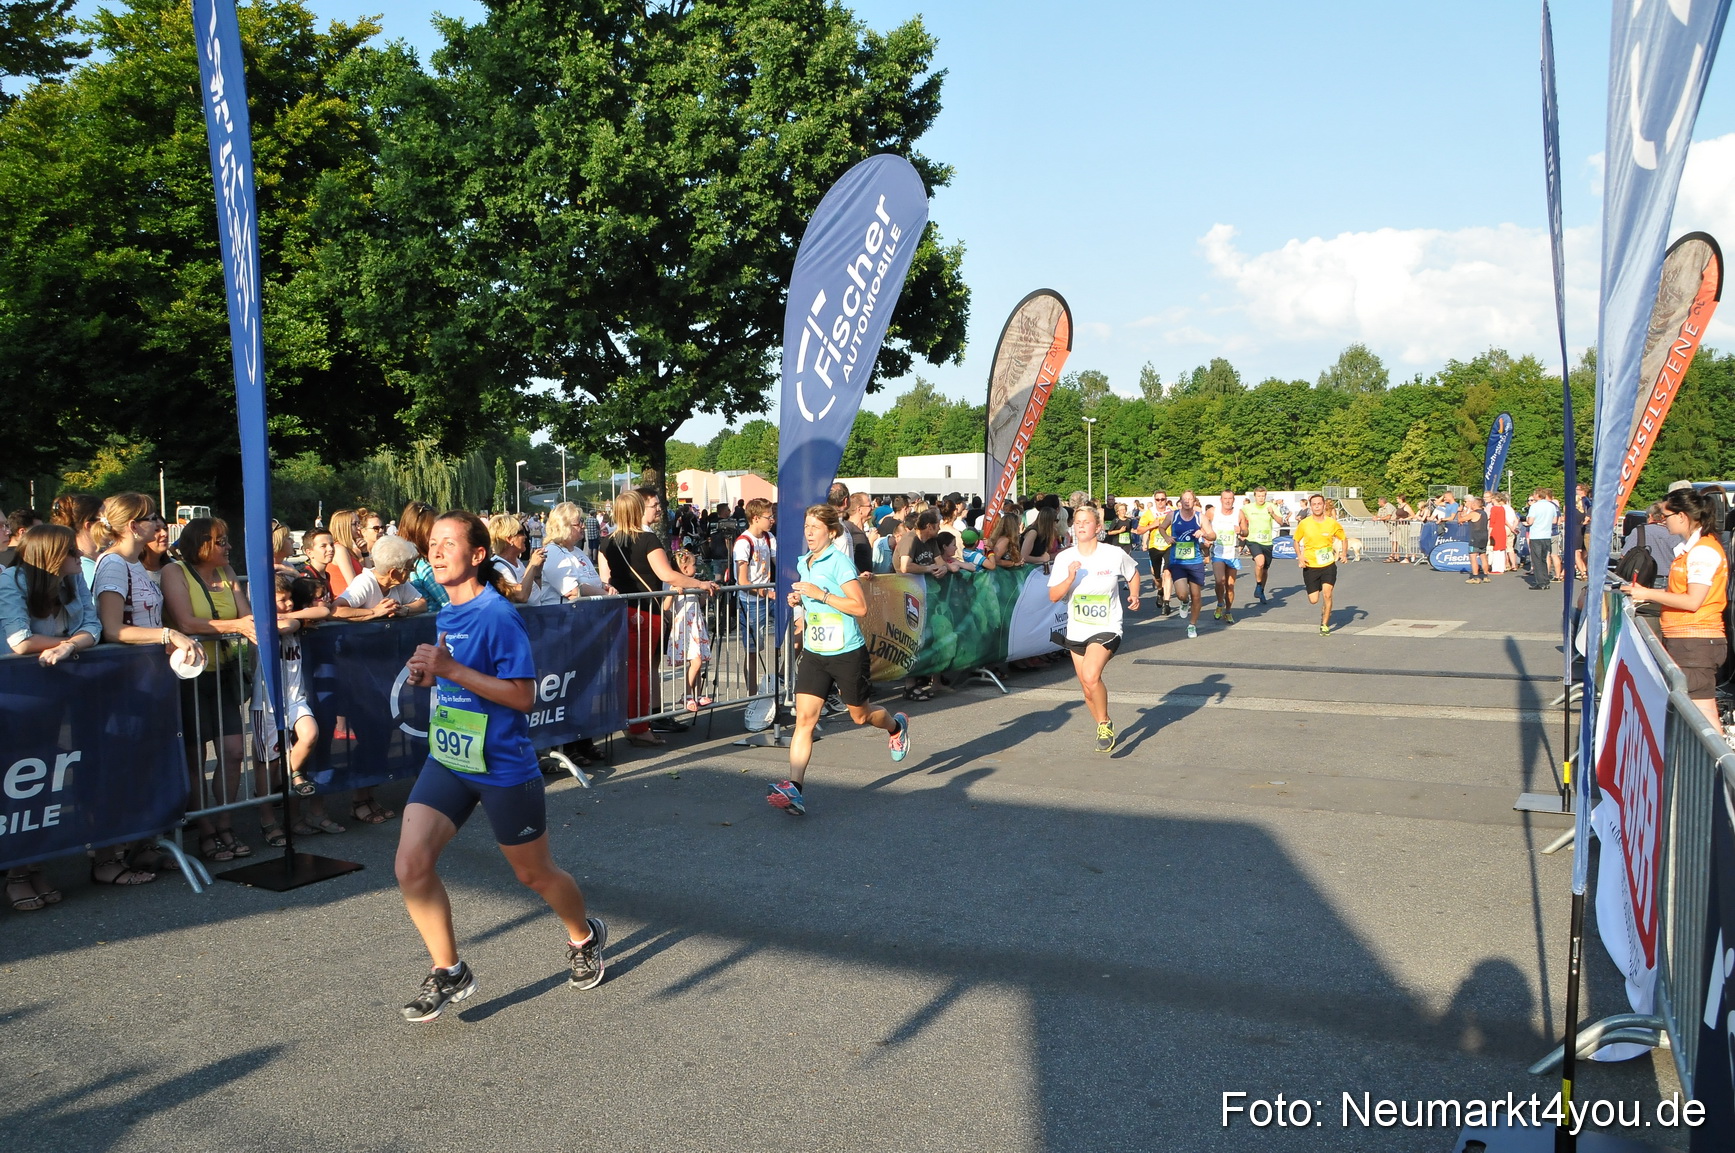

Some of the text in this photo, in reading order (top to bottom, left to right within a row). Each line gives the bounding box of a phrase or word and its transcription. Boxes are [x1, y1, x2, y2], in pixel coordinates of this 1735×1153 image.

[814, 194, 891, 389] Fischer
[842, 223, 902, 384] AUTOMOBILE
[1219, 534, 1231, 542] 521
[1178, 548, 1192, 556] 739
[1321, 552, 1330, 561] 50
[1075, 604, 1107, 618] 1068
[811, 626, 835, 642] 387
[534, 670, 576, 703] er
[526, 706, 565, 728] BILE
[436, 728, 474, 759] 997
